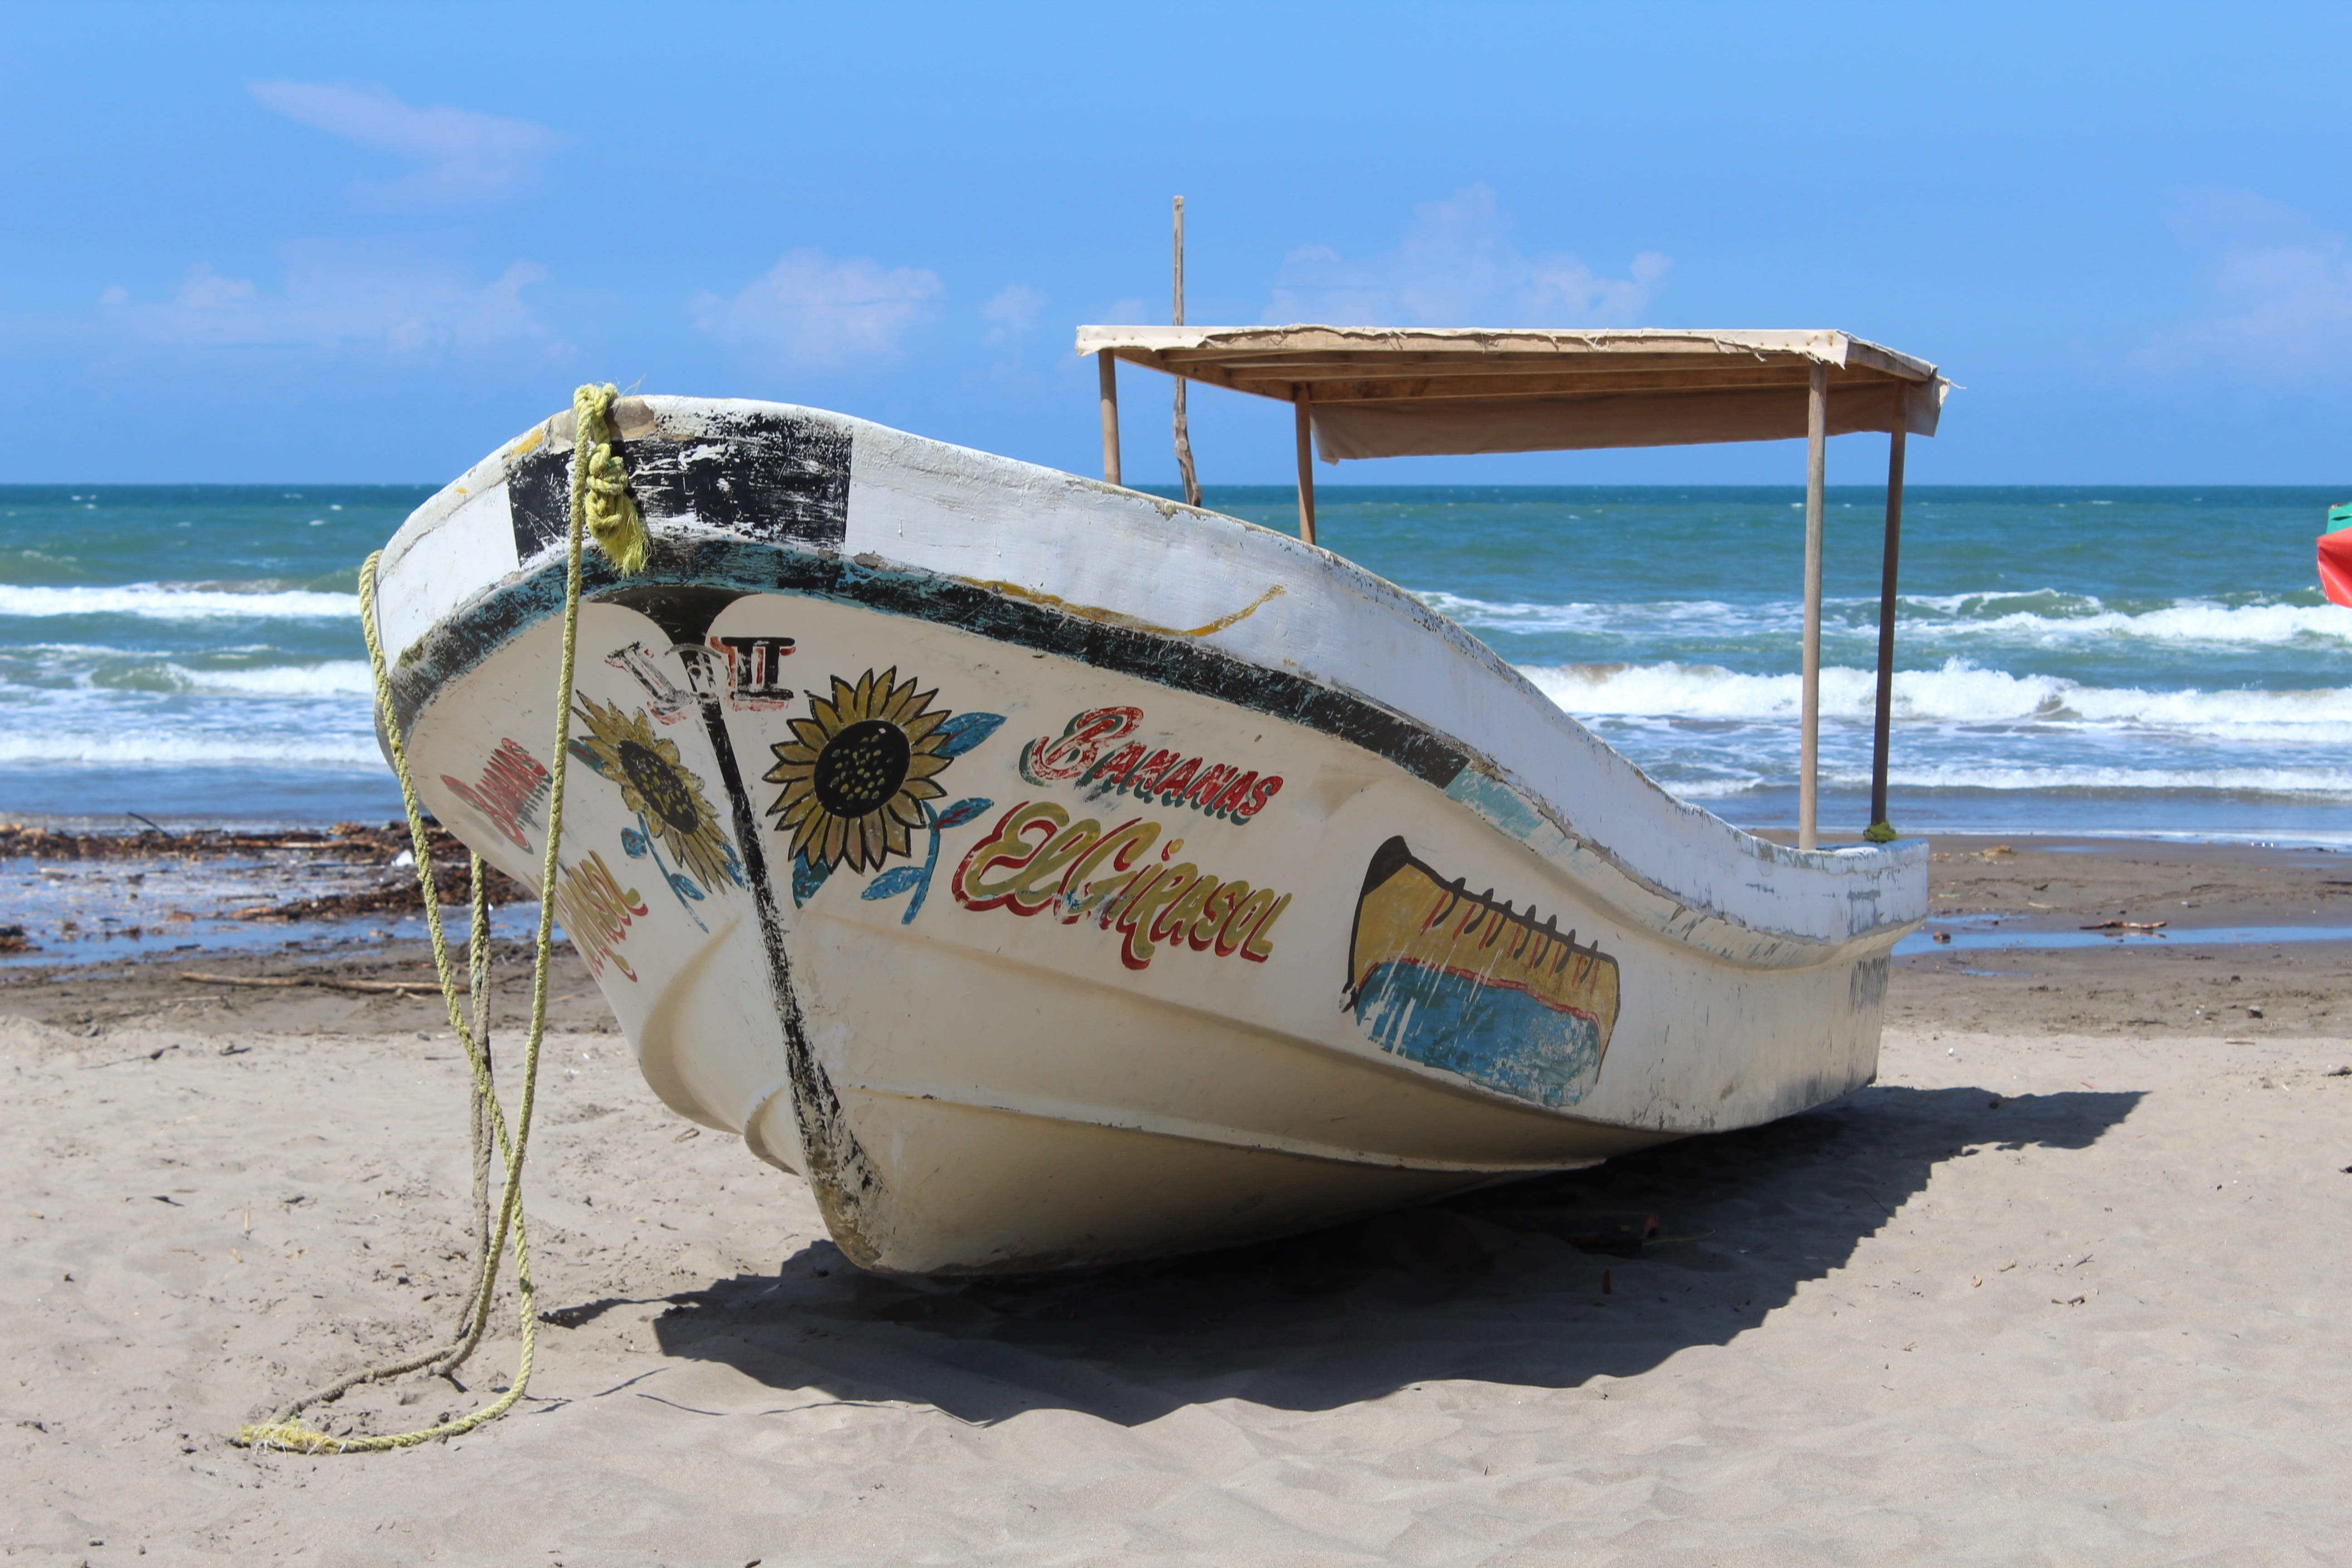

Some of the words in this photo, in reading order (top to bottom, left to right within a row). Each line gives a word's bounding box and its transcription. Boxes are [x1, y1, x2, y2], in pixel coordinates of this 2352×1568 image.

[440, 737, 553, 854] BANANAS
[1019, 706, 1283, 825] BANANAS
[951, 801, 1101, 916] El
